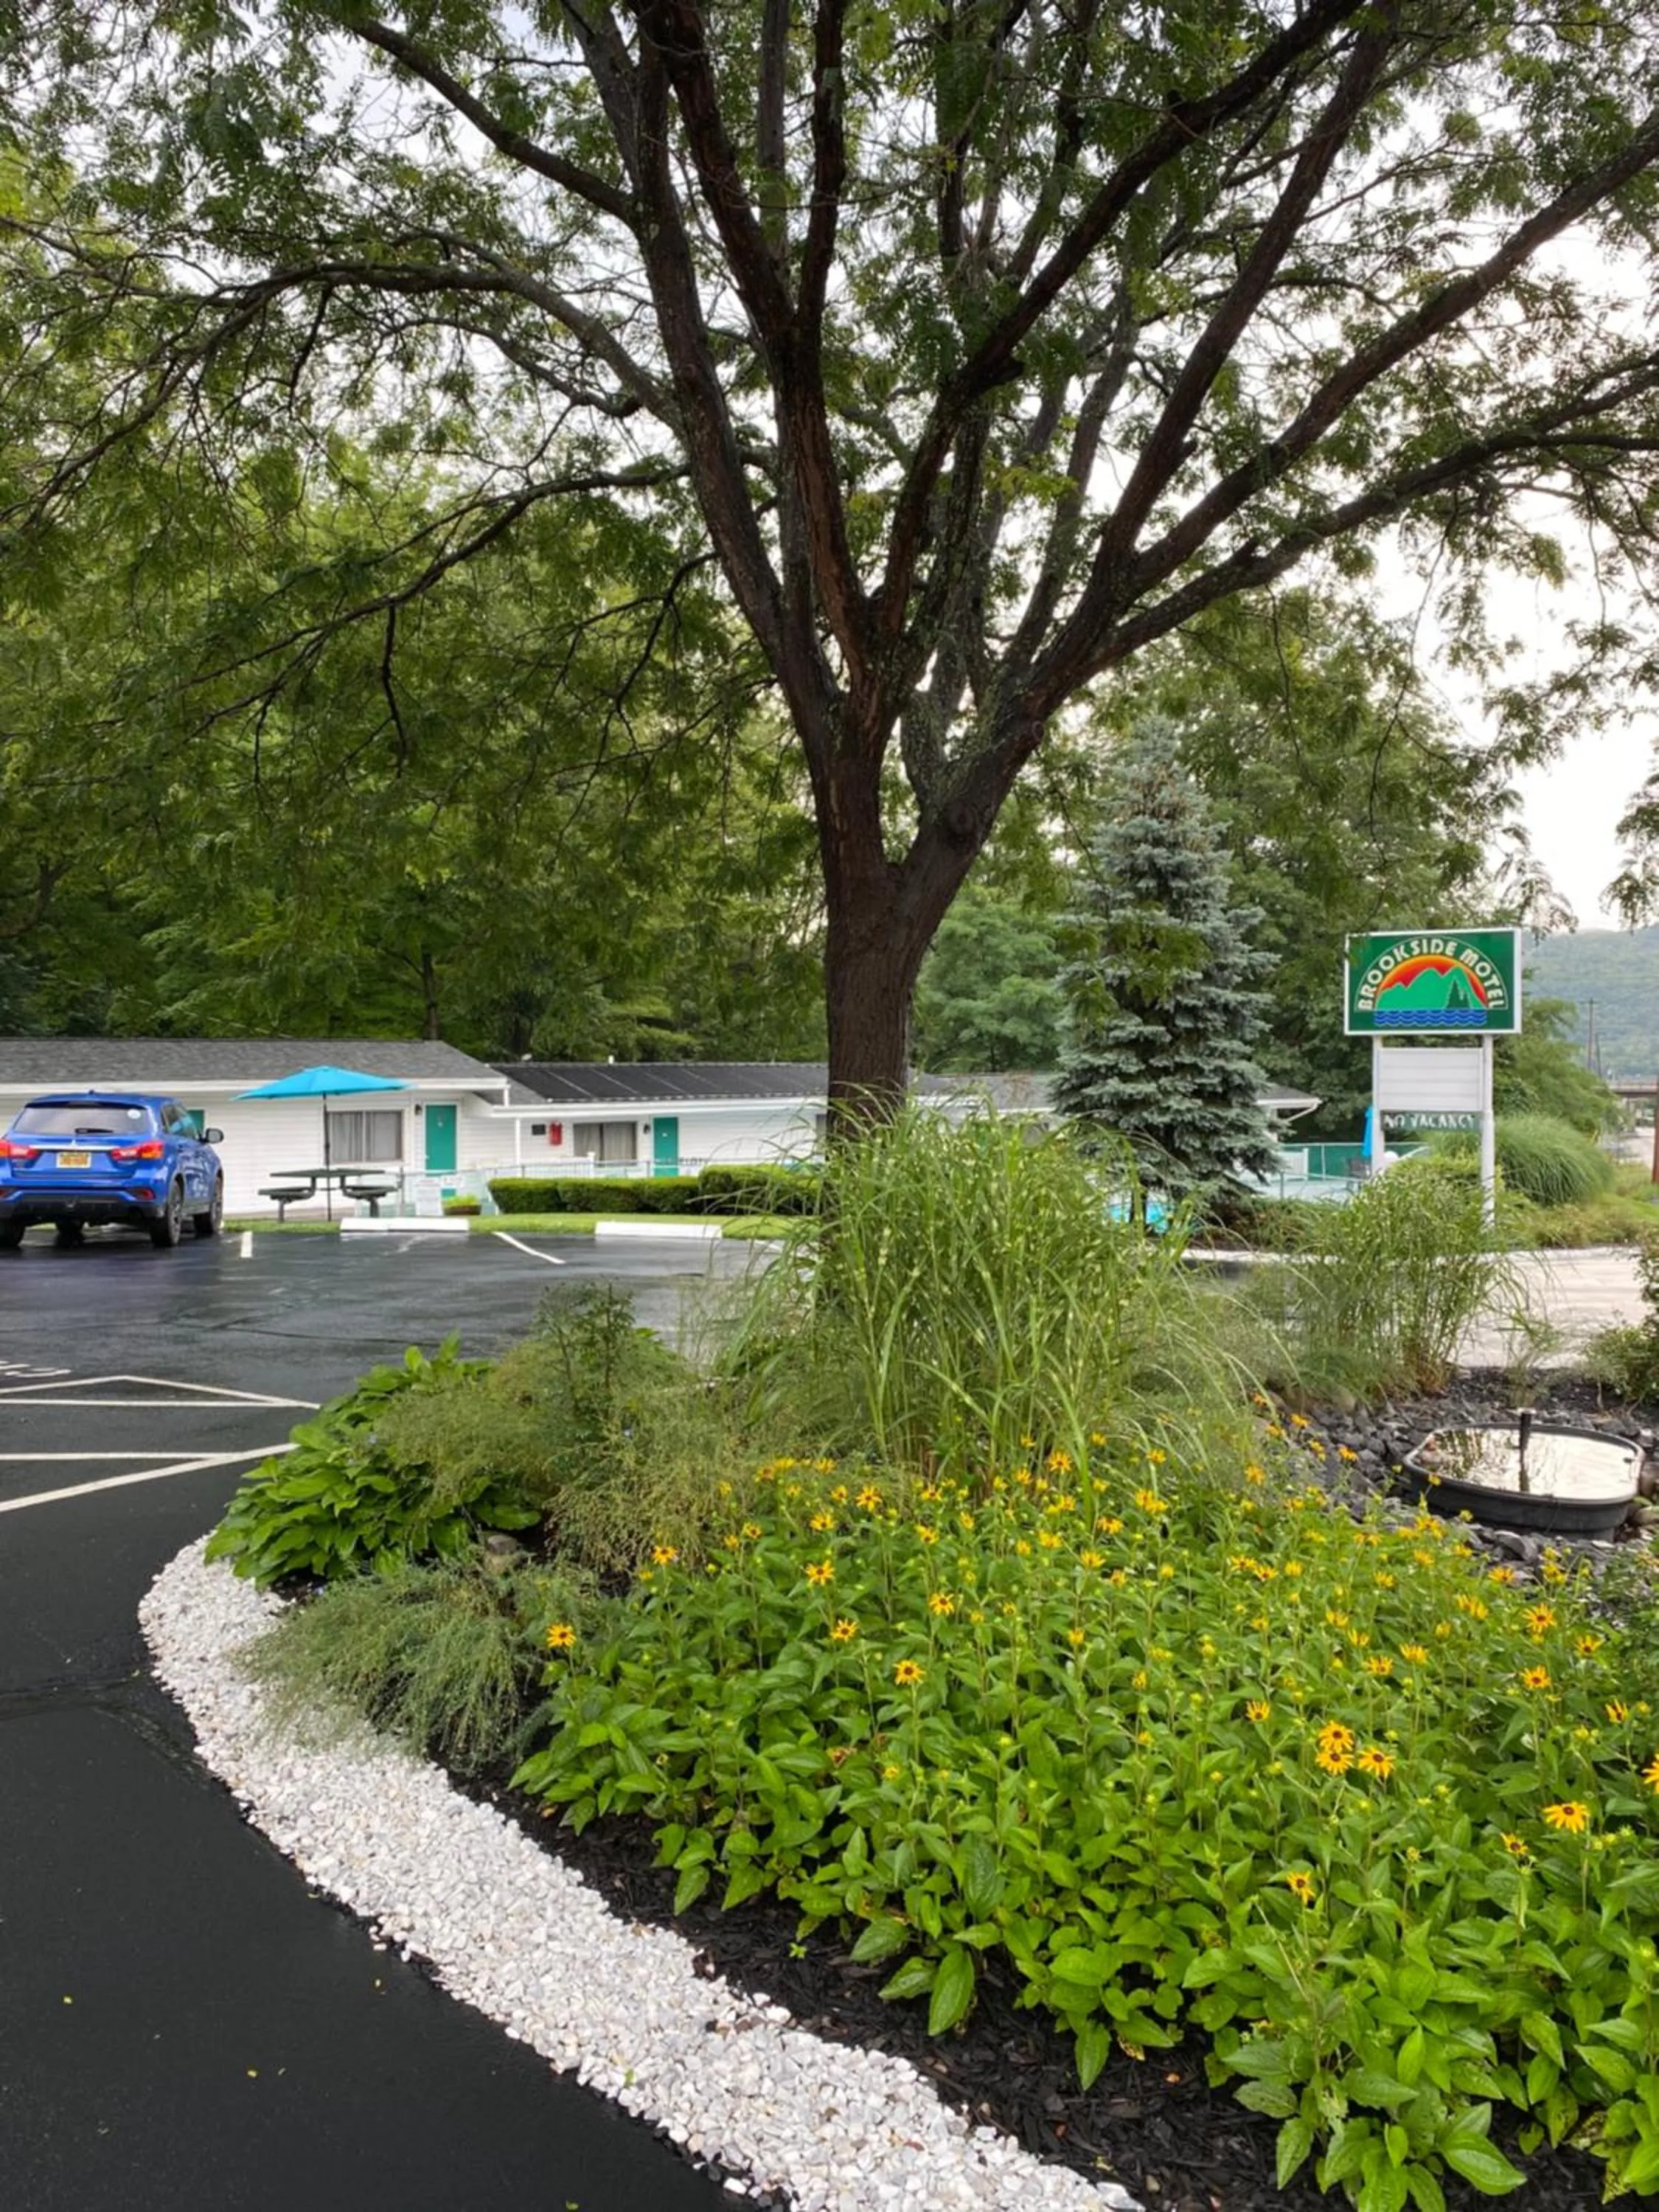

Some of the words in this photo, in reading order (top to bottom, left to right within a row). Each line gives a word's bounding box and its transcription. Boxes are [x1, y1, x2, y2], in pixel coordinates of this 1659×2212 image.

[1357, 938, 1458, 1010] BROOKSIDE
[1459, 948, 1505, 1009] MOTEL
[1383, 1113, 1405, 1128] NO
[1409, 1113, 1475, 1129] VACANCY
